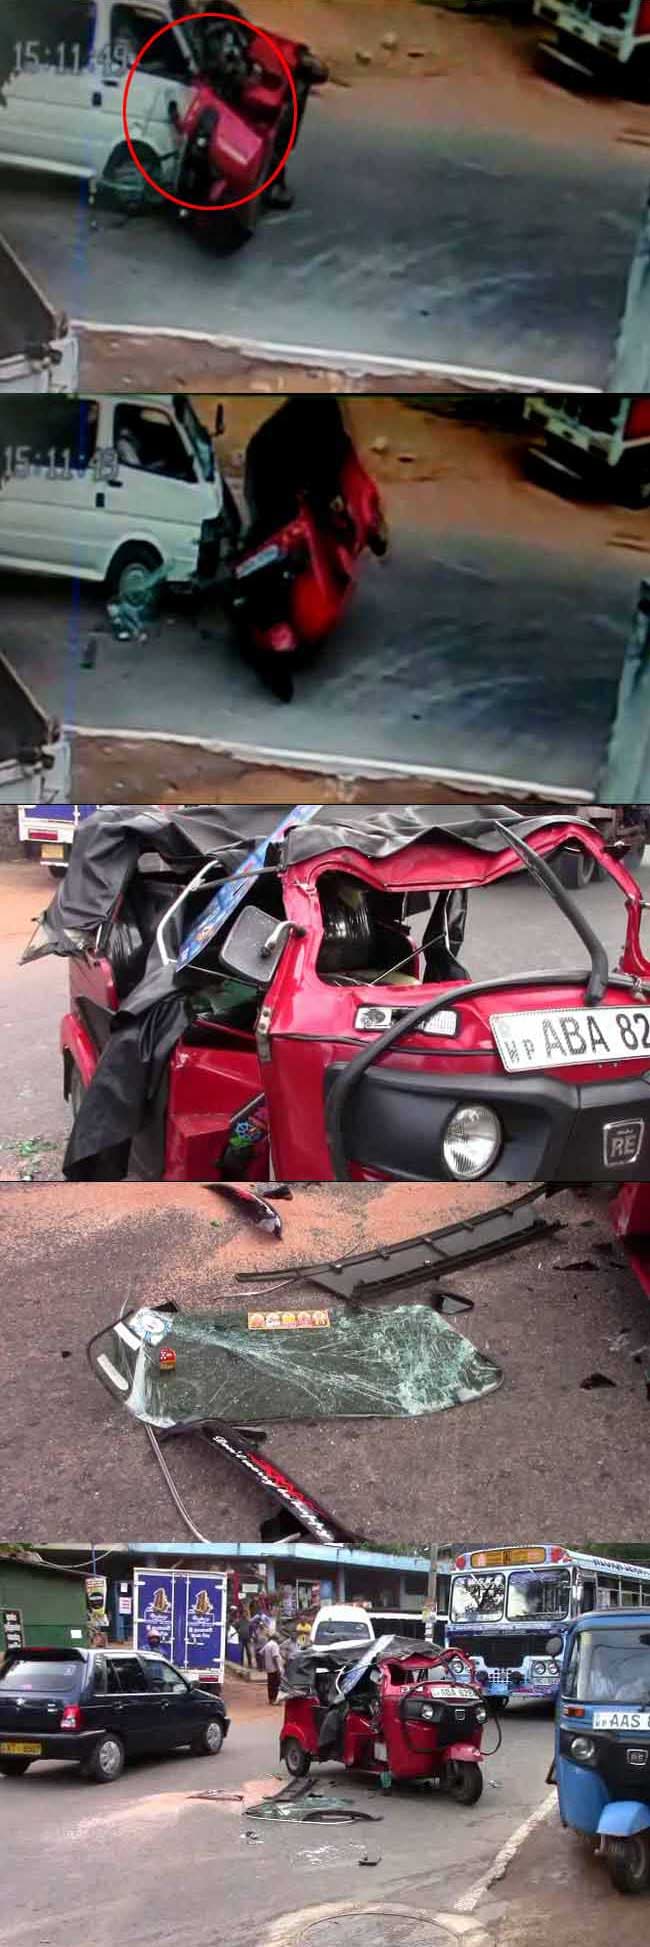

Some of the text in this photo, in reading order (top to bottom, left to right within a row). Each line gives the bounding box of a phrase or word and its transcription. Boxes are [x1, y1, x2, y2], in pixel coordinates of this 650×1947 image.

[542, 1016, 610, 1058] ABA
[616, 1013, 650, 1051] 82
[610, 1135, 637, 1157] RE
[610, 1713, 641, 1728] AAS
